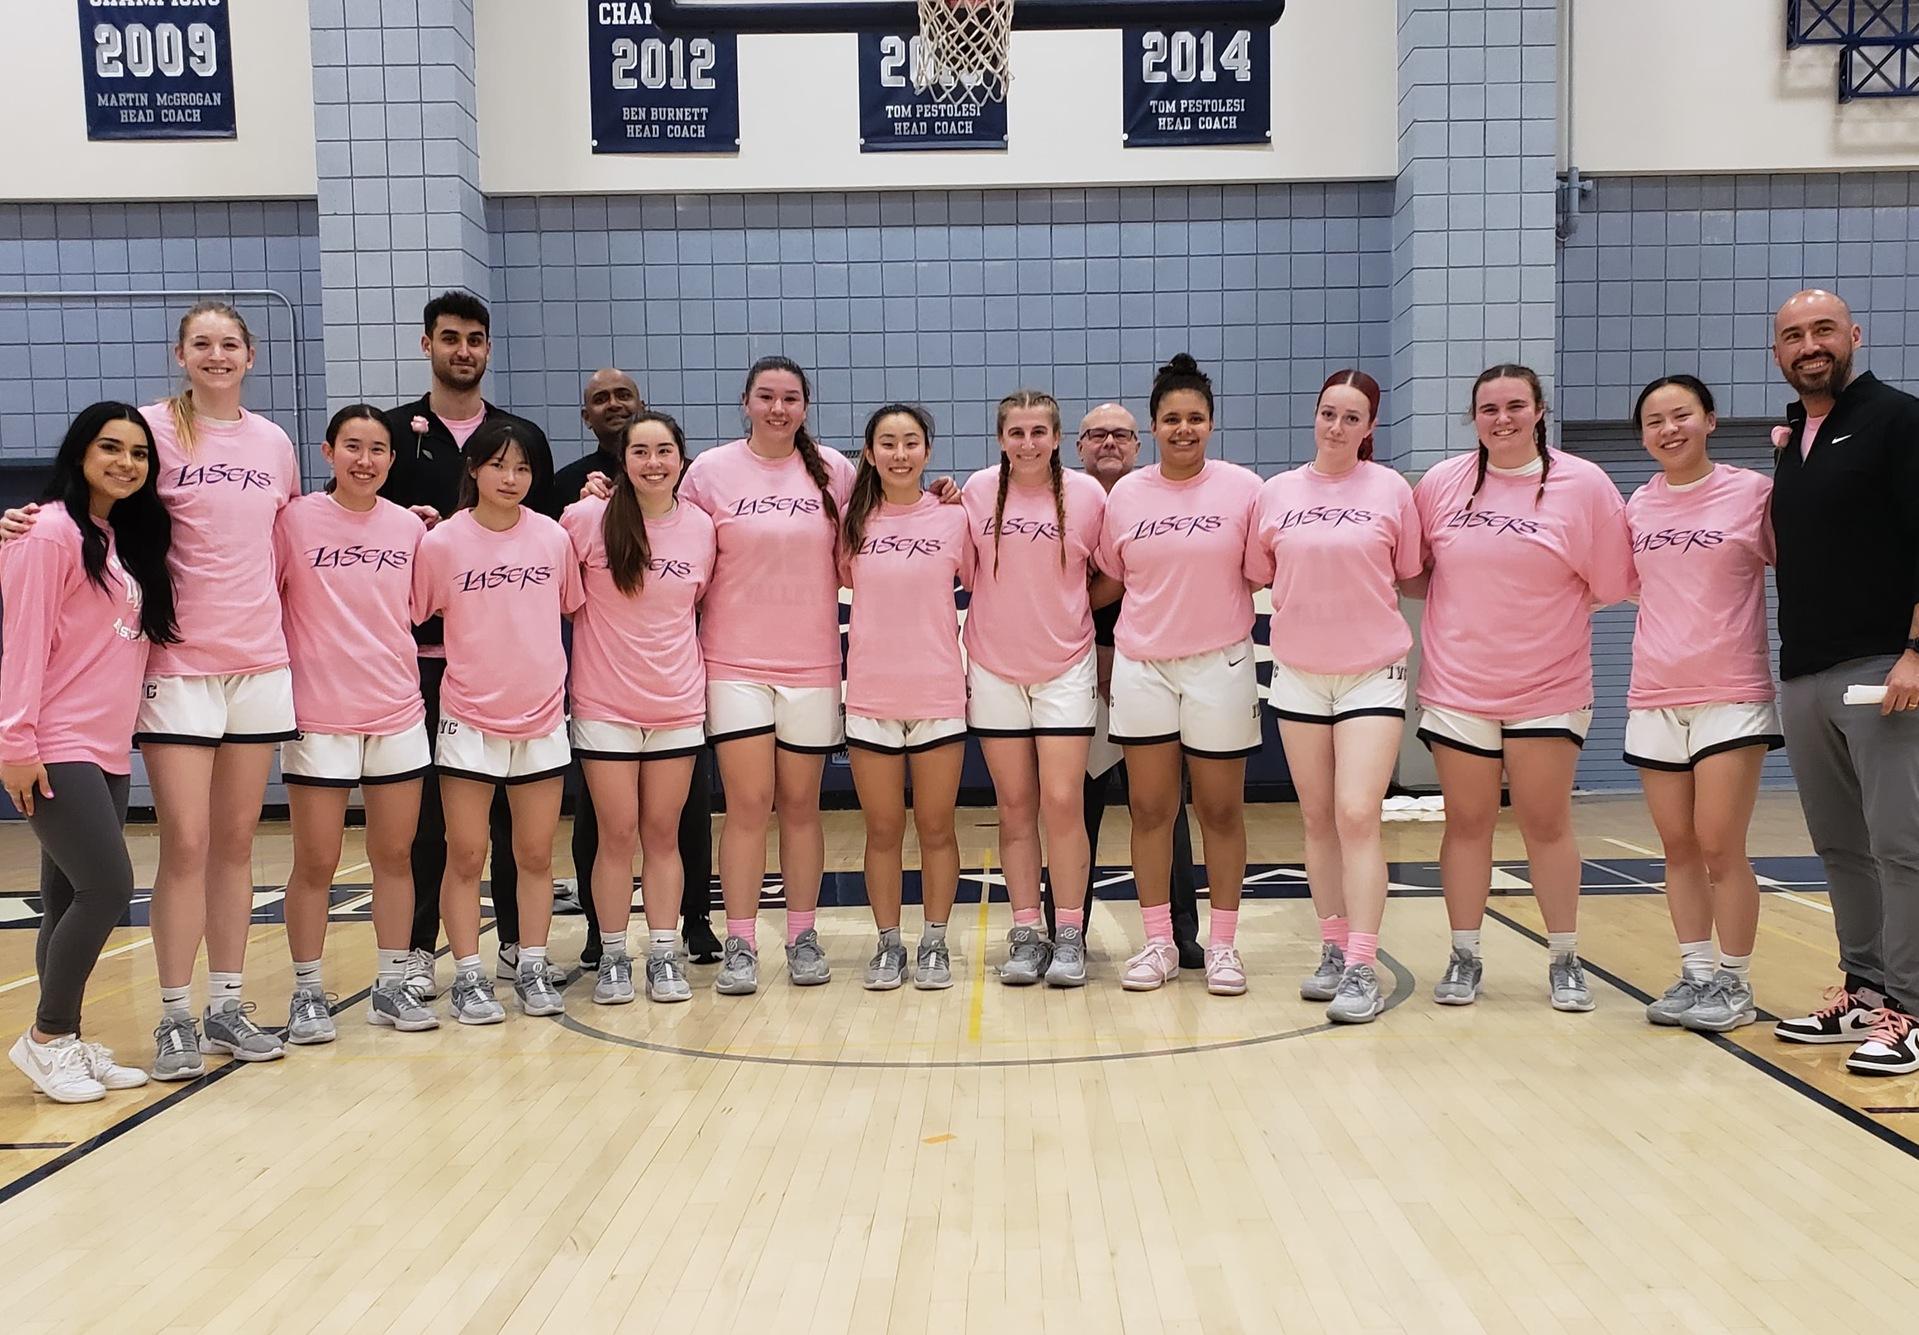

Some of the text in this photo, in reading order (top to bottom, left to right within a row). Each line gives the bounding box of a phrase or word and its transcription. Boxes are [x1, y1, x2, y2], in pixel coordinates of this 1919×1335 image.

[94, 23, 217, 77] 2009
[1142, 30, 1251, 83] 2014
[611, 38, 716, 90] 2012
[880, 35, 984, 87] 20
[97, 93, 222, 107] MARTIN McGROGAN
[1150, 99, 1246, 114] TOM PESTOLESI
[120, 109, 202, 123] HEAD COACH
[622, 107, 709, 121] BEN BURNETT
[885, 104, 981, 119] TOM PESTOLESI
[894, 121, 973, 136] HEAD COACH
[1158, 116, 1238, 131] HEAD COACH
[626, 125, 706, 138] HEAD COACH
